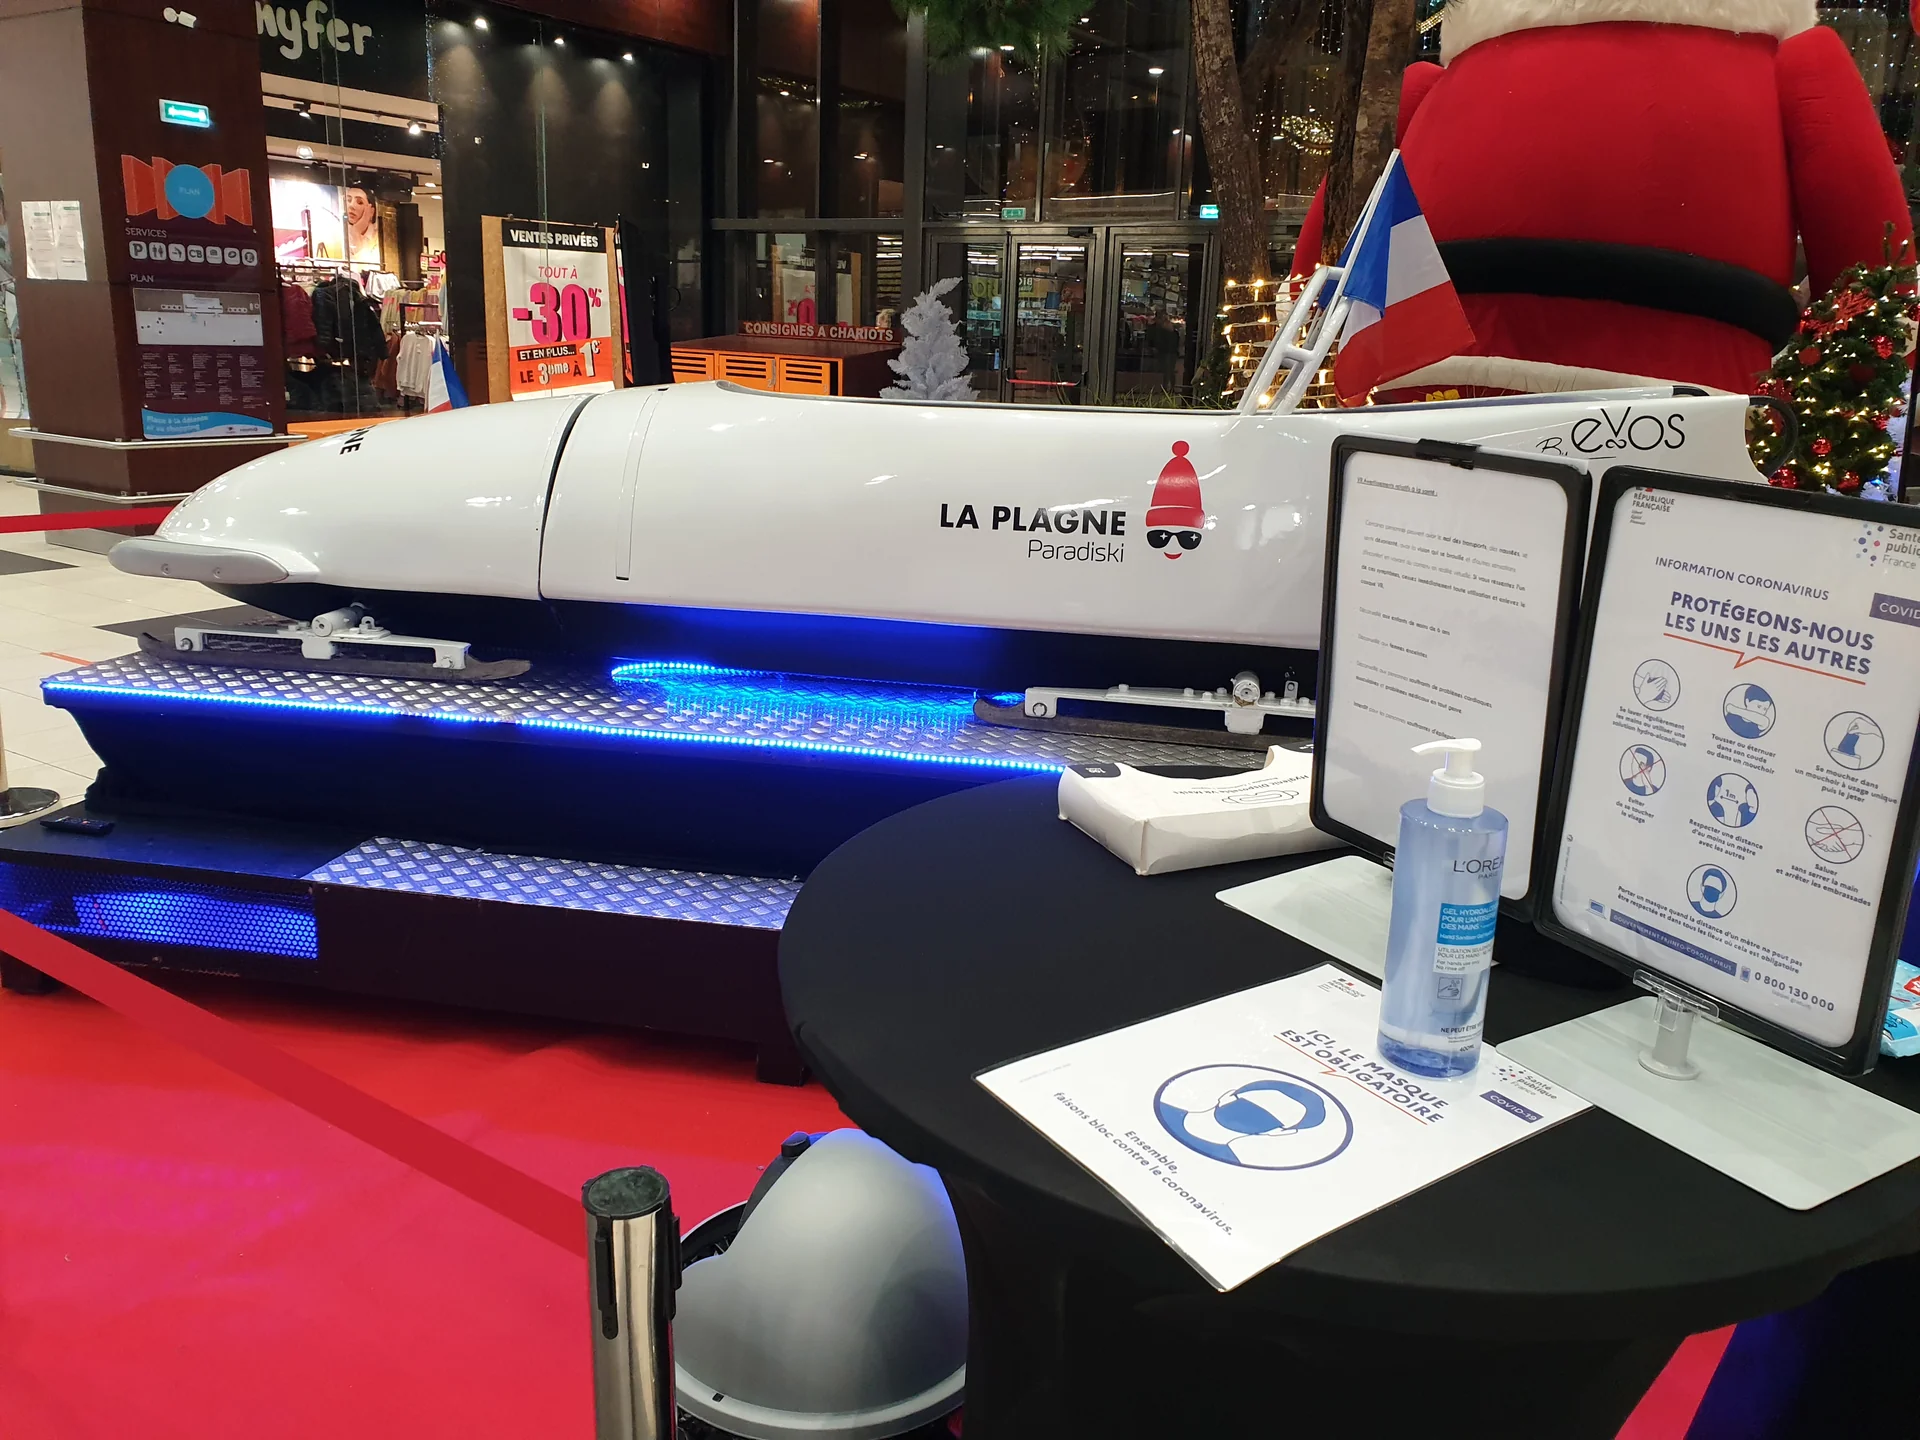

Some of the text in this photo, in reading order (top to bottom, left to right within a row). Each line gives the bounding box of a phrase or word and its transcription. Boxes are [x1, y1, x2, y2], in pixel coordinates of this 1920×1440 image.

[125, 228, 166, 238] SERVICES
[510, 229, 598, 247] VENTES PRIVÉES
[130, 274, 154, 282] PLAN
[539, 266, 568, 278] TOUT
[745, 322, 893, 341] CONSIGNES A CHARIOTS
[520, 351, 531, 360] ET
[533, 350, 544, 358] EN
[520, 370, 534, 383] LE
[1632, 500, 1671, 512] FRANÇAISE
[1634, 492, 1675, 505] RÉPUBLIQUE
[940, 503, 1127, 536] LA PLAGNE
[1028, 536, 1124, 563] Paradiski
[1882, 554, 1916, 569] France
[1655, 556, 1829, 601] INFORMATION CORONAVIRUS
[1670, 591, 1875, 651] PROTÉGEONS-NOUS
[1665, 613, 1872, 675] LES UNS LES AUTRES
[1626, 717, 1642, 725] mains
[1652, 724, 1672, 734] utiliser
[1643, 714, 1684, 730] régulièrement
[1613, 721, 1686, 747] solution hydro-alcoolique
[1712, 733, 1736, 745] Tousser
[1747, 744, 1776, 758] éternuer
[1717, 744, 1731, 752] dans
[1746, 754, 1767, 764] coude
[1717, 752, 1731, 761] dans
[1743, 761, 1775, 774] mouchoir
[1806, 771, 1840, 786] mouchoir
[1848, 785, 1869, 795] usage
[1871, 792, 1897, 804] unique
[1826, 769, 1858, 782] moucher
[1860, 780, 1878, 789] dans
[1821, 786, 1836, 794] puis
[1846, 792, 1865, 803] jeter
[1628, 813, 1645, 823] visage
[1632, 806, 1654, 818] toucher
[1689, 819, 1720, 834] Respecter
[1735, 836, 1763, 849] distance
[1692, 829, 1705, 837] d'au
[1707, 835, 1725, 844] moins
[1737, 845, 1756, 856] mètre
[1699, 840, 1713, 848] avec
[1725, 850, 1744, 860] autres
[1791, 865, 1806, 874] sans
[1808, 871, 1830, 882] serrer
[1840, 883, 1858, 893] main
[1815, 864, 1837, 876] Saluer
[1785, 871, 1809, 884] arrêter
[1811, 880, 1821, 888] les
[1823, 886, 1870, 906] embrassades
[1442, 915, 1465, 923] POUR
[1443, 907, 1458, 916] GEL
[1618, 886, 1635, 897] Porter
[1645, 898, 1667, 911] masque
[1669, 909, 1688, 920] quand
[1696, 919, 1722, 934] distance
[1725, 931, 1738, 941] d'un
[1740, 937, 1760, 949] mètre
[1772, 951, 1789, 960] peut
[1790, 957, 1802, 967] pas
[1618, 893, 1629, 902] être
[1630, 900, 1658, 915] respectée
[1667, 916, 1681, 925] dans
[1683, 922, 1696, 931] tous
[1698, 927, 1706, 936] les
[1707, 931, 1722, 943] lieux
[1734, 944, 1747, 953] cela
[1749, 950, 1759, 958] est
[1761, 954, 1799, 974] obligatoire
[1755, 972, 1761, 980] 0
[1764, 976, 1786, 990] 800
[1789, 986, 1808, 1000] 130
[1811, 996, 1834, 1011] 000
[1280, 1030, 1444, 1123] EST OBLIGATOIRE
[1306, 1030, 1448, 1109] ICI, LE MASQUE
[1510, 1081, 1536, 1096] France
[1516, 1078, 1557, 1100] publique
[1526, 1074, 1552, 1091] Santé
[1490, 1095, 1538, 1122] COVID-19
[1125, 1130, 1177, 1174] Ensemble,
[1053, 1092, 1232, 1236] faisons bloc contre le coronavirus.
